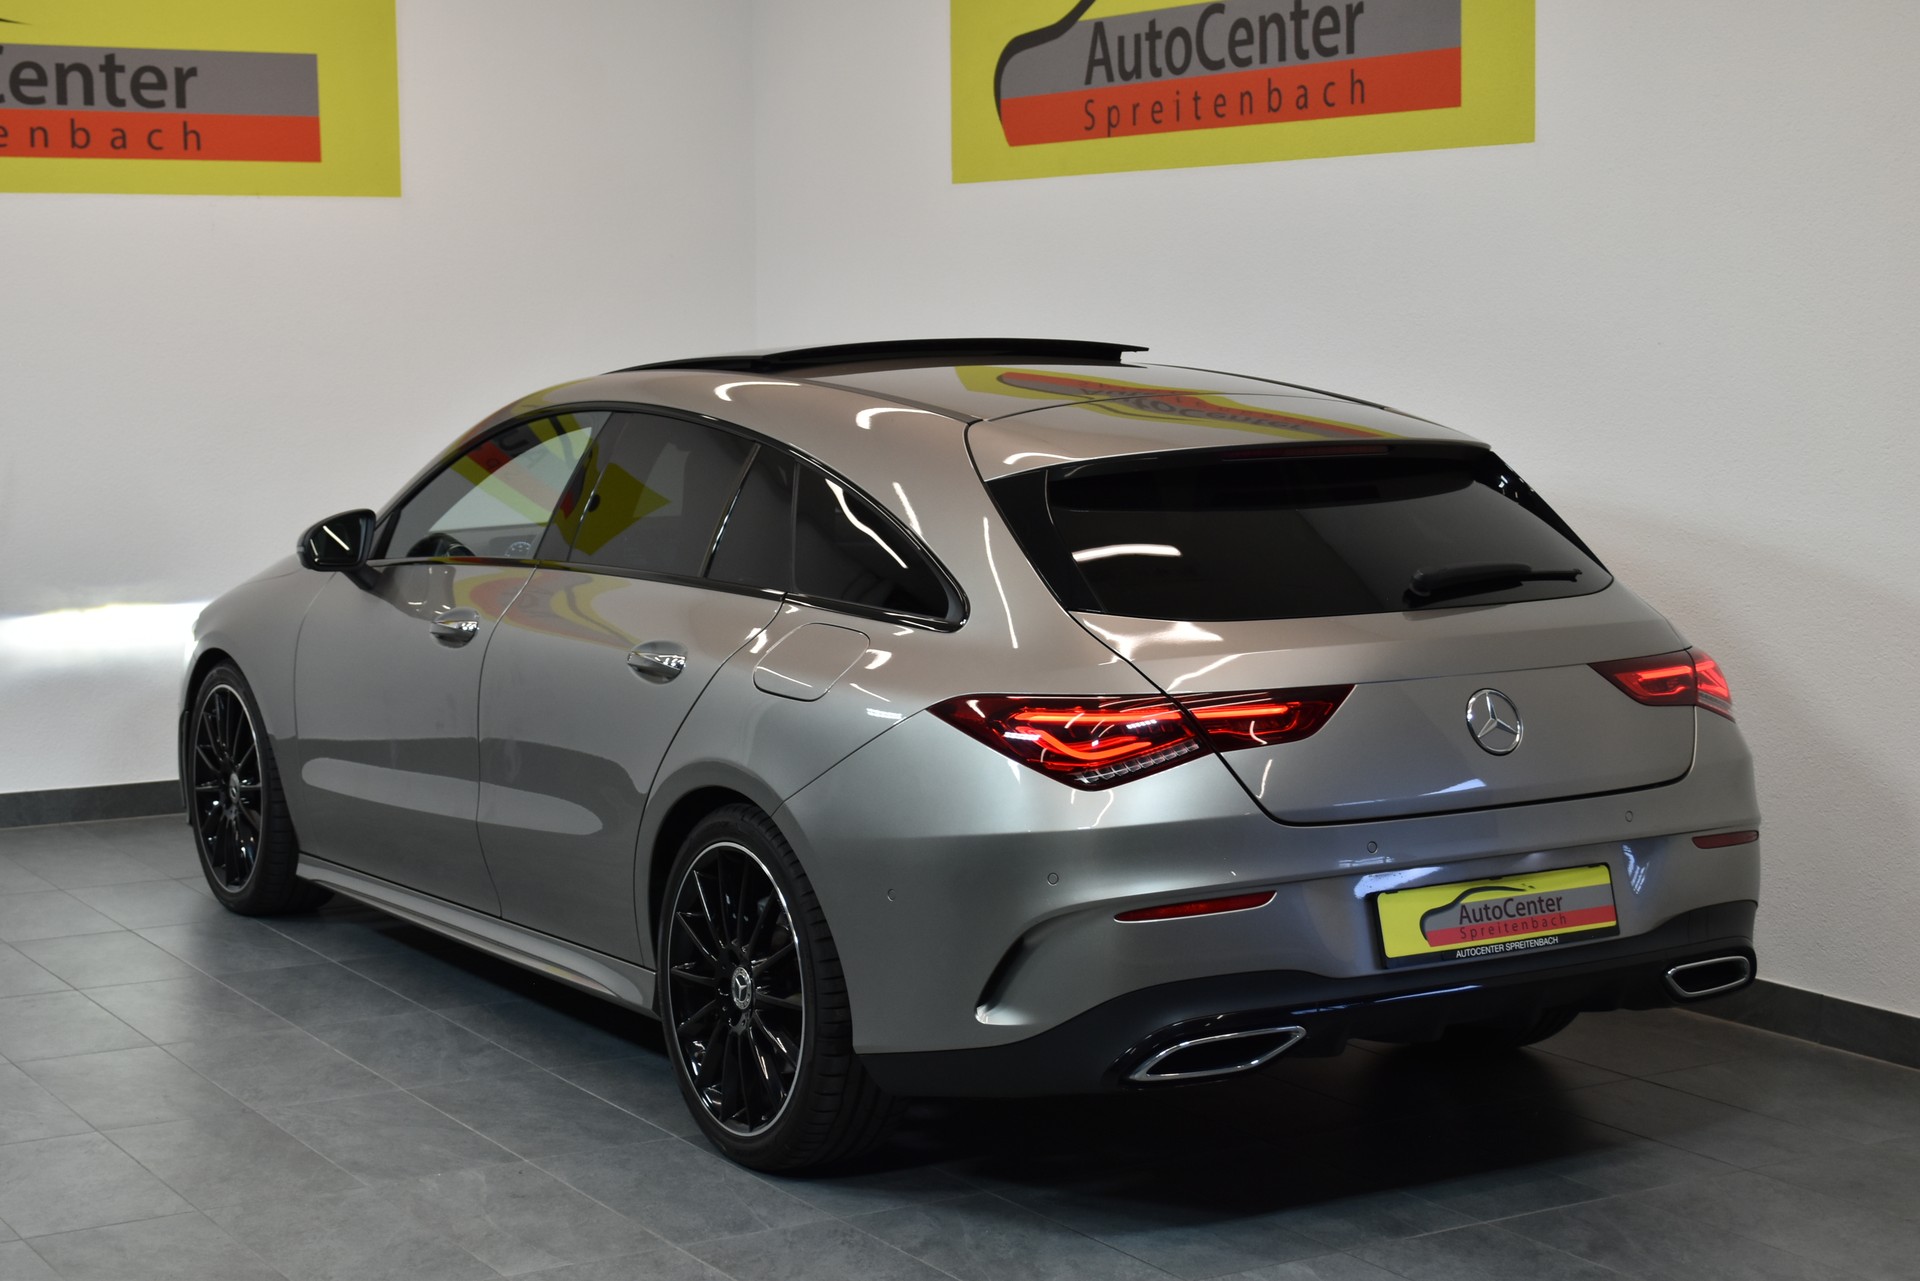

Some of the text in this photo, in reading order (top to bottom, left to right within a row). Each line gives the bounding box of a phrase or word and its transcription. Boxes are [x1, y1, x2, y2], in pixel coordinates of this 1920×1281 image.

[1083, 0, 1365, 86] AutoCenter
[0, 45, 198, 109] enter
[1084, 69, 1366, 137] Spreitenbach
[1459, 896, 1562, 925] AutoCenter
[1460, 914, 1567, 940] Spreitenbach
[1456, 936, 1559, 958] AUTOCENTER SPREITENBACH
